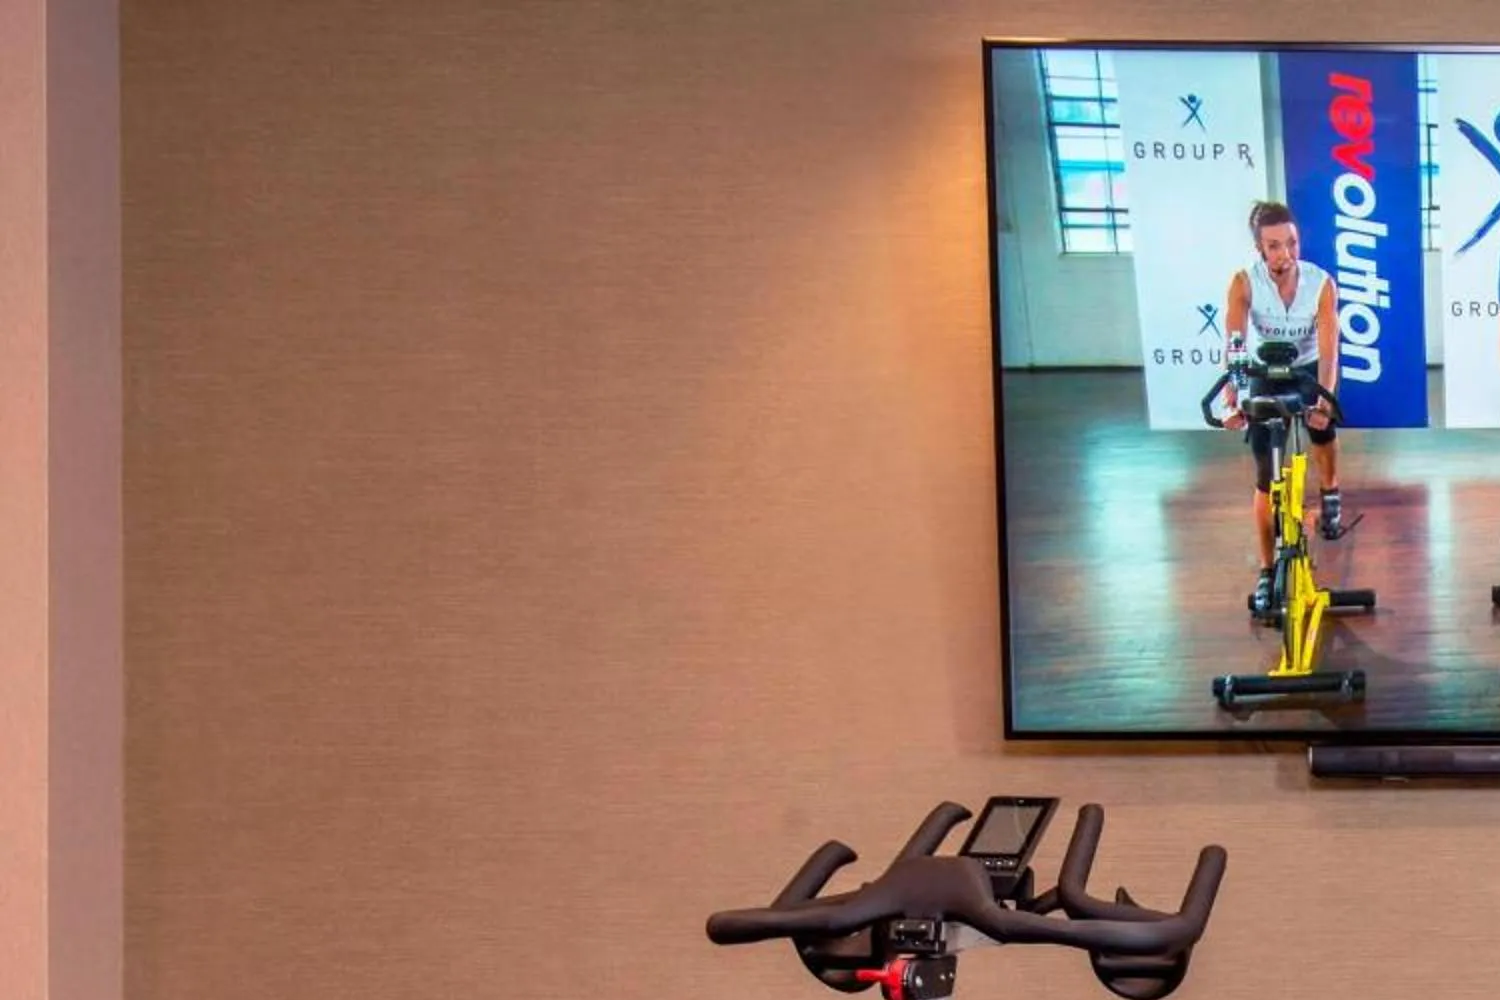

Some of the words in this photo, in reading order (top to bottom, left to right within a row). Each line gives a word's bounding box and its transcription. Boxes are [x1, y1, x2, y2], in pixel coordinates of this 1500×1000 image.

[1133, 141, 1225, 161] GROUP
[1328, 72, 1391, 383] revolution
[1451, 301, 1499, 317] GRO
[1153, 348, 1221, 365] GROU
